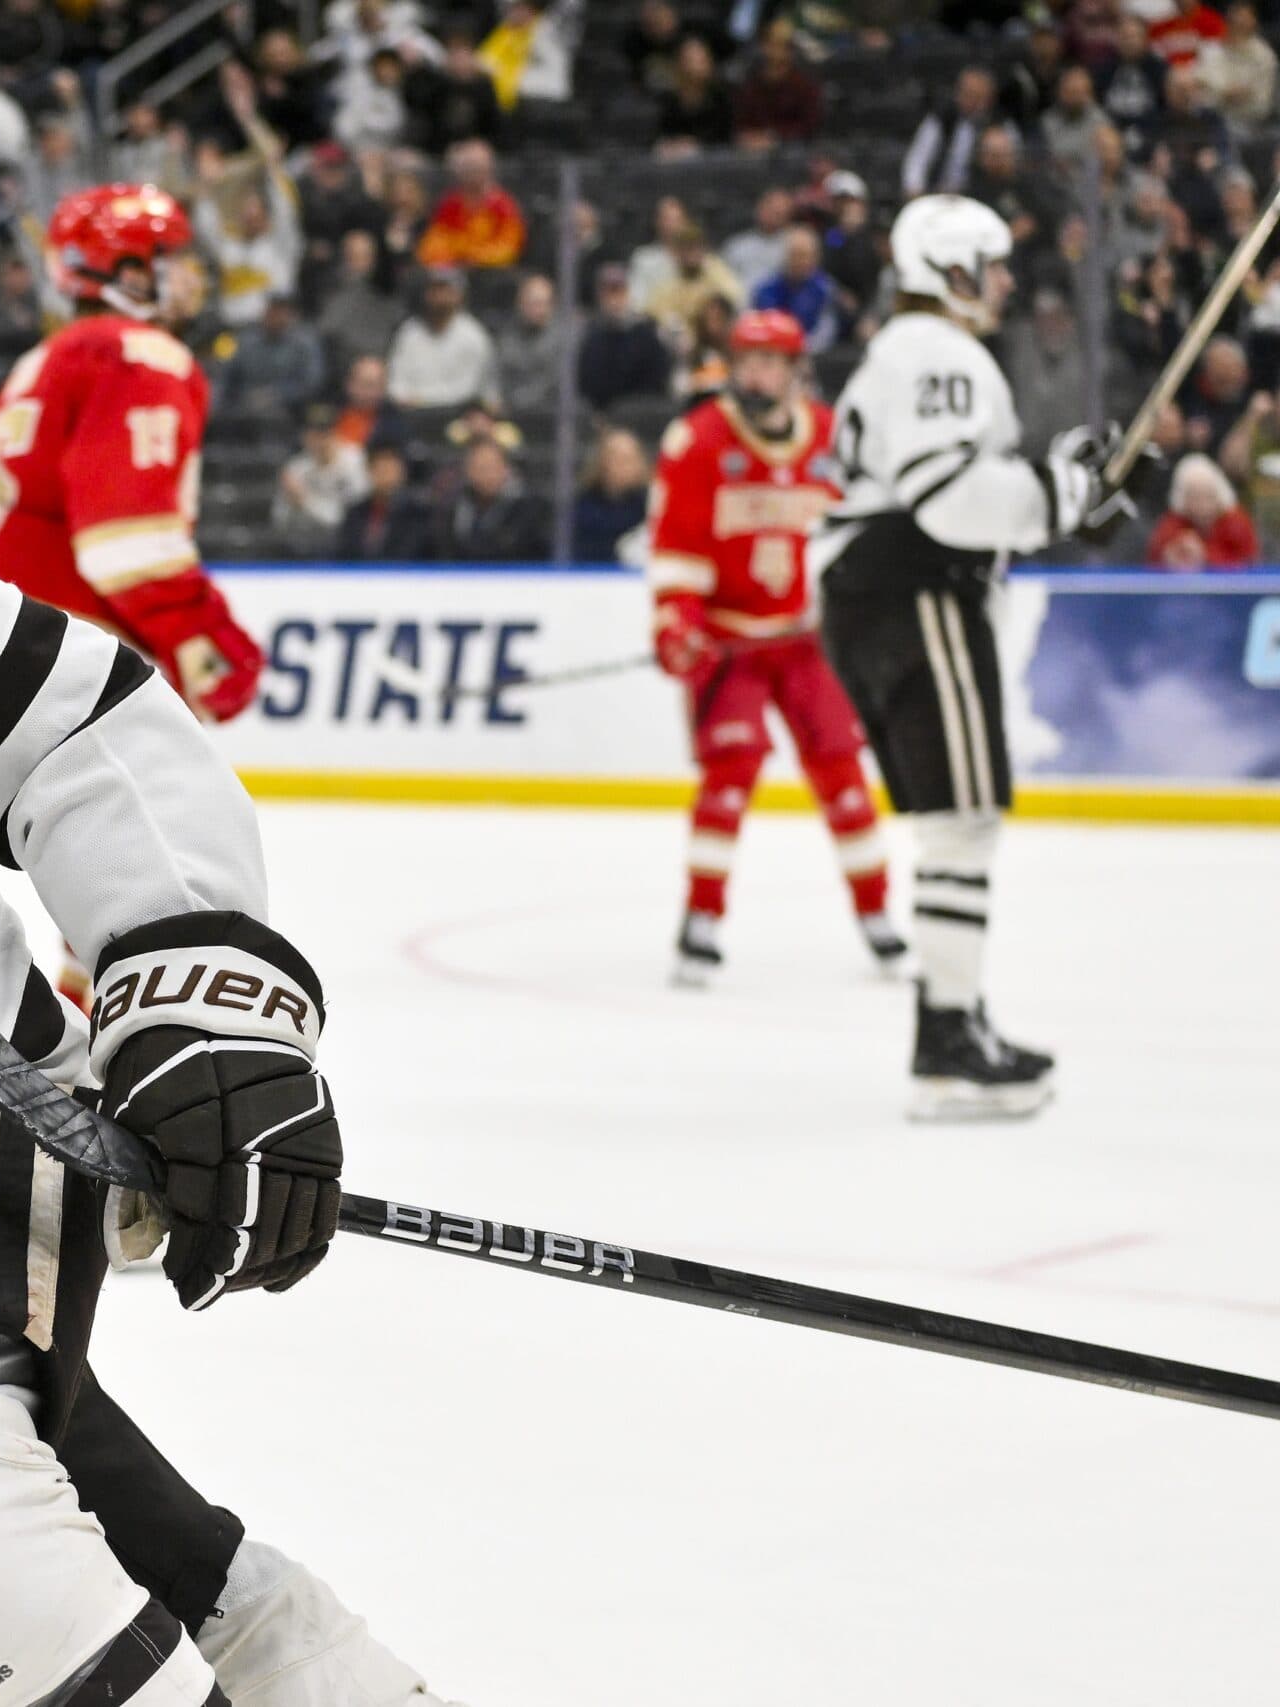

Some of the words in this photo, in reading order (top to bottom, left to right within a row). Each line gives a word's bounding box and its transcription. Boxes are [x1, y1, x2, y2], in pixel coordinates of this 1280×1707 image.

[915, 371, 974, 418] 20
[262, 618, 539, 724] STATE
[379, 1200, 637, 1284] BAUER
